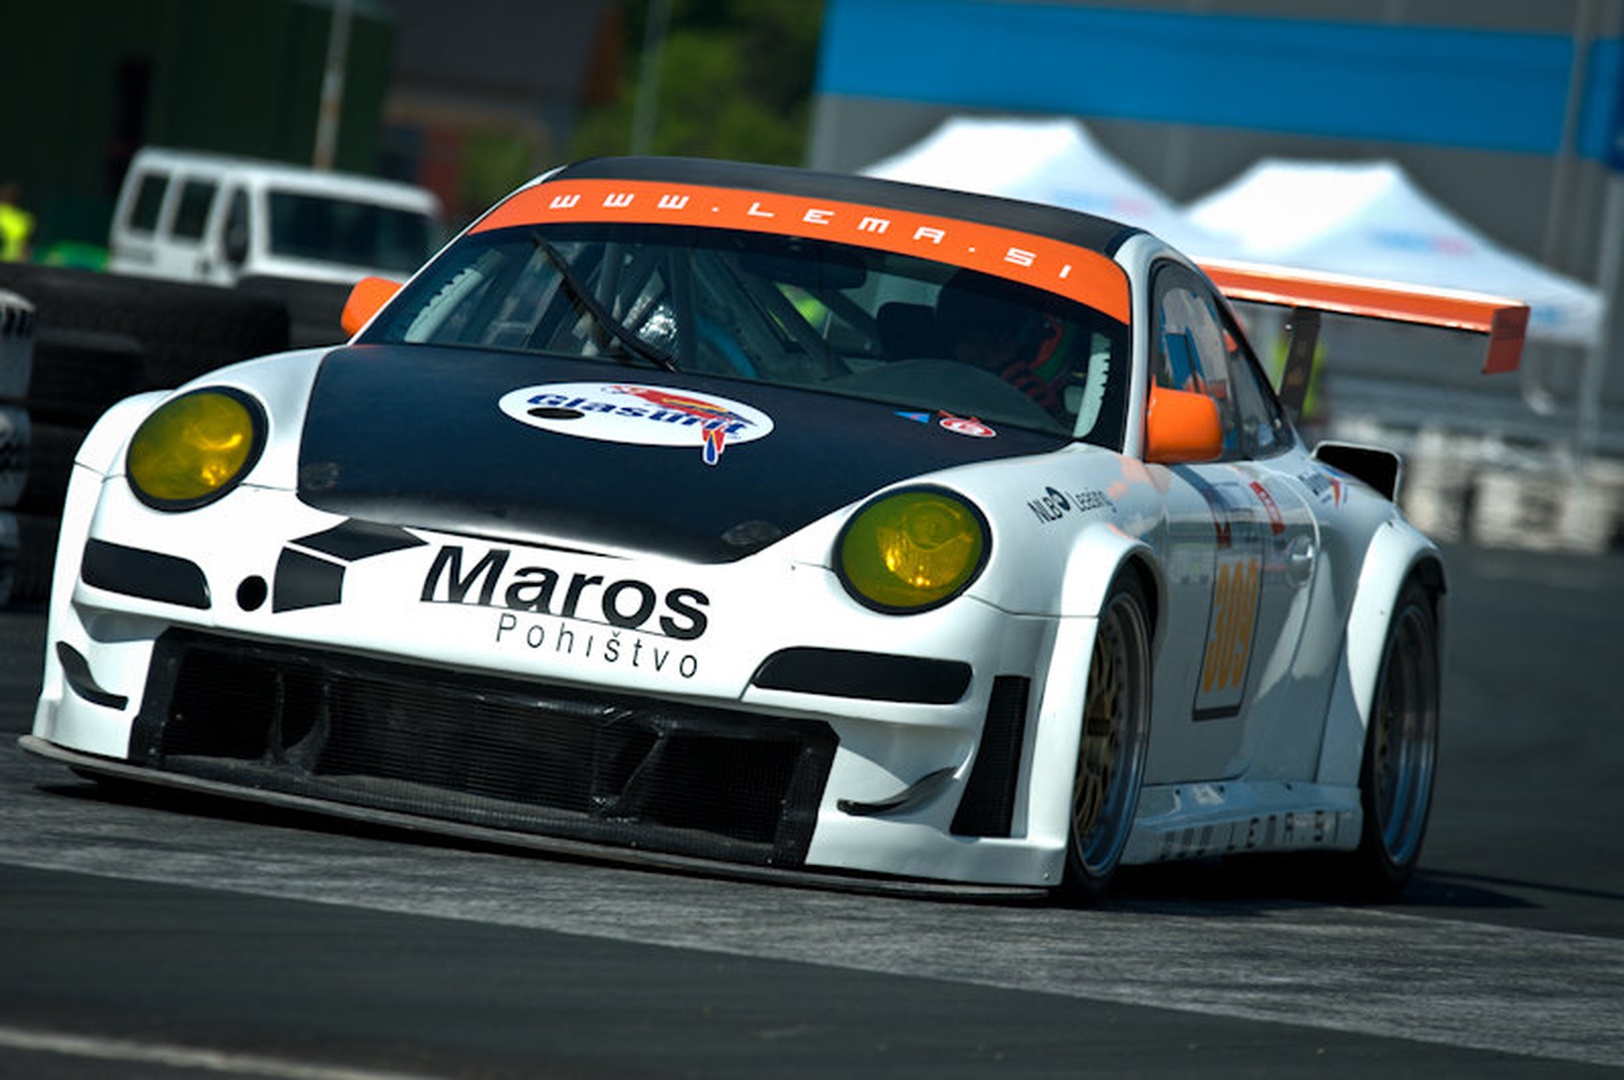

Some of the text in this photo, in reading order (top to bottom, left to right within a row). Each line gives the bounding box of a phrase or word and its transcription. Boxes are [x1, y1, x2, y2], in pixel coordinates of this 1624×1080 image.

[526, 392, 748, 434] Glasurit
[1027, 496, 1063, 524] NLB
[419, 545, 711, 641] Maros
[496, 612, 698, 678] Pohištvo
